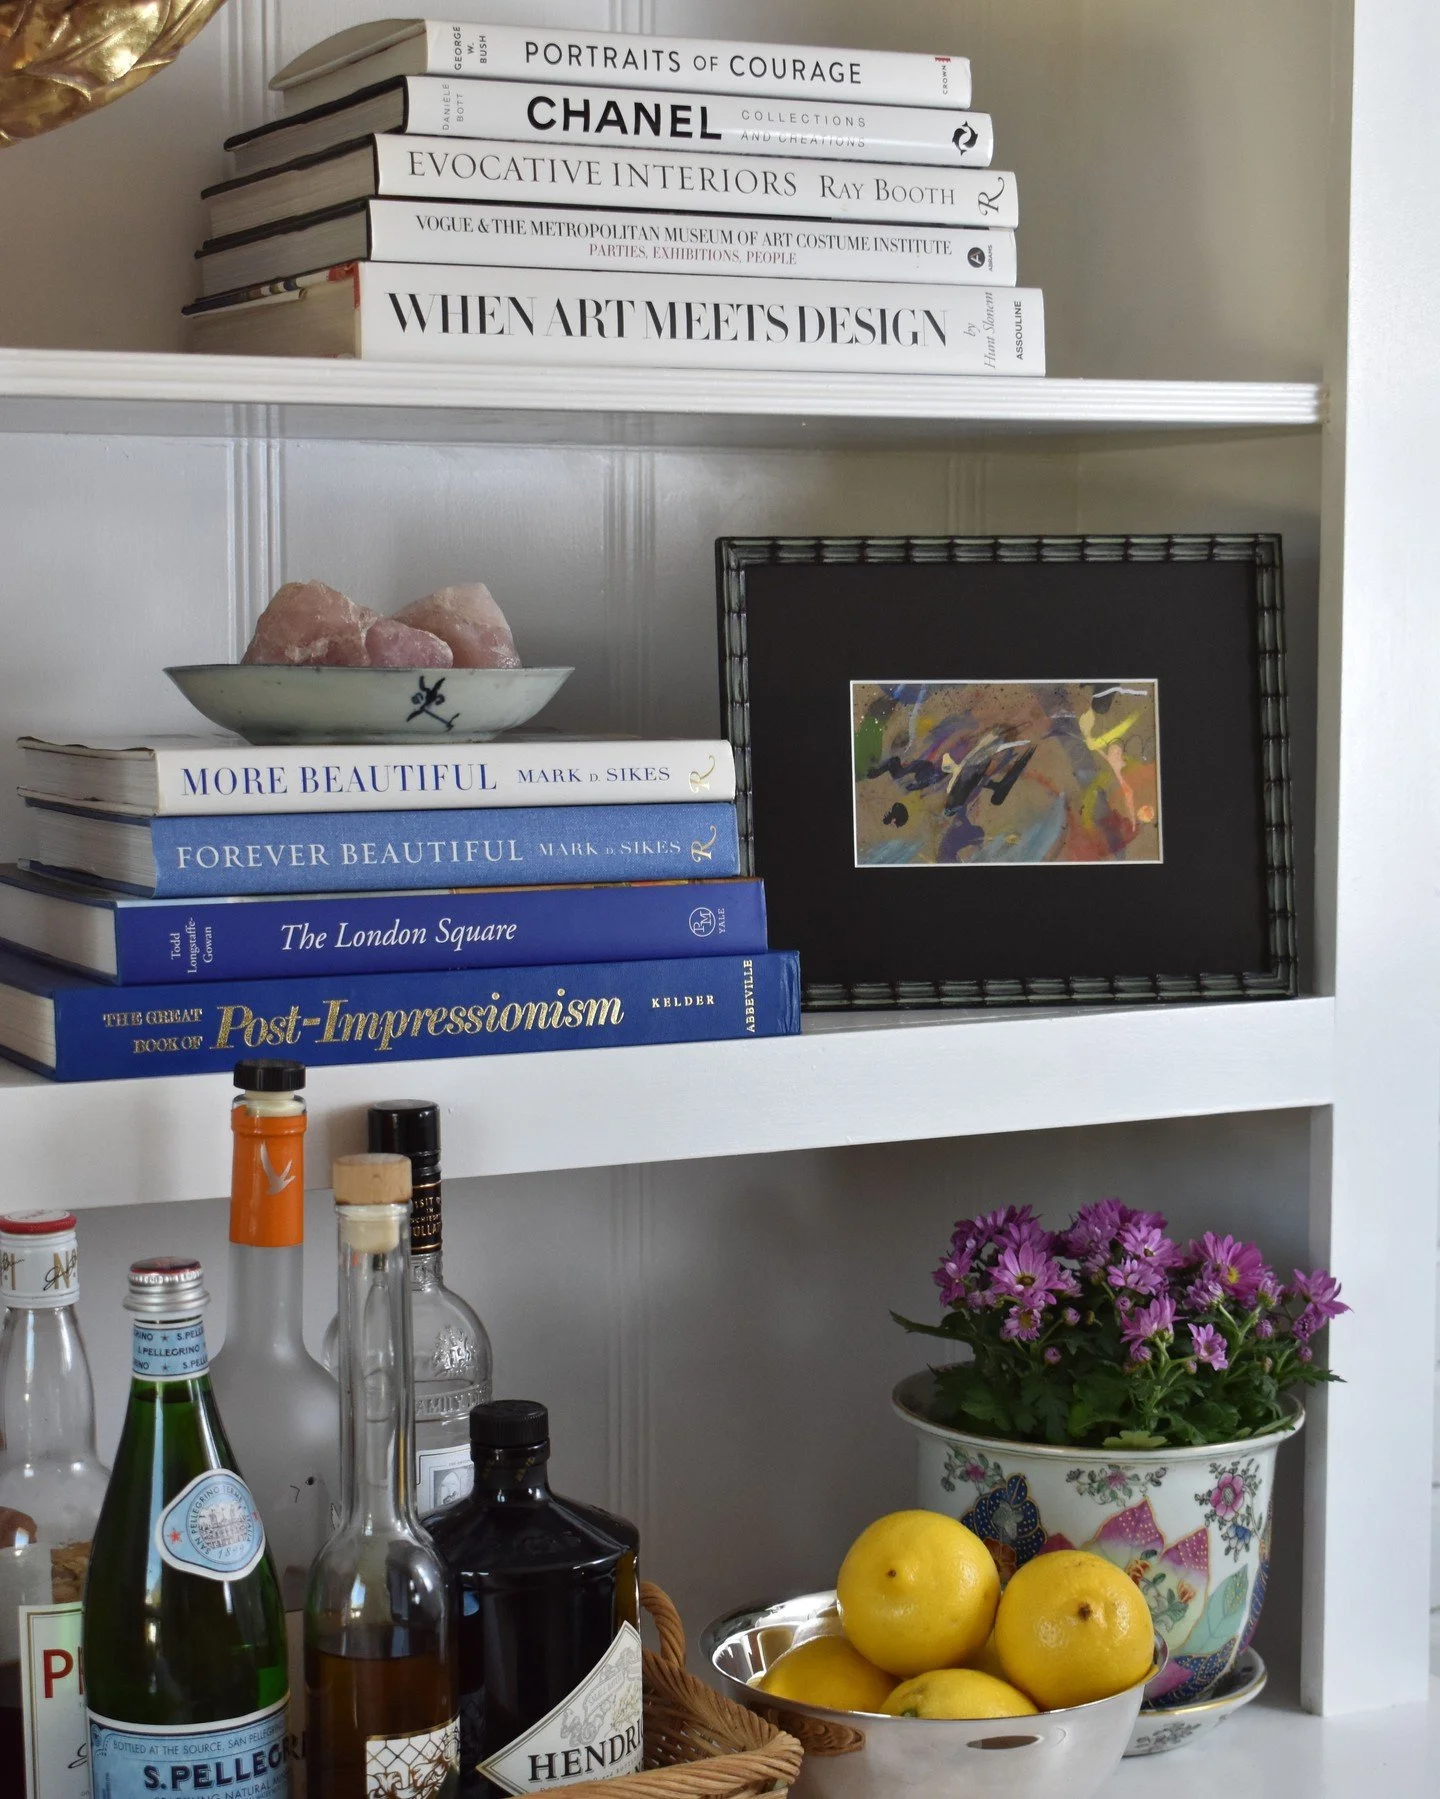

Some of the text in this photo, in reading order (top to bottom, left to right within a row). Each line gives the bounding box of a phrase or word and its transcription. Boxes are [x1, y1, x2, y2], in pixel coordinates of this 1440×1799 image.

[453, 26, 463, 71] GEORGE
[467, 42, 475, 54] W.
[479, 35, 487, 64] BUSH
[525, 41, 862, 85] PORTRAITS OF COURAGE
[456, 94, 464, 122] BOTT
[527, 96, 722, 140] CHANEL
[741, 109, 867, 128] COLLECTIONS
[741, 130, 866, 149] AND CREATIONS
[408, 151, 955, 206] EVOCATIVE INTERIORS RAY BOOTH
[416, 215, 952, 255] VOGUE & THE METROPOLITAN MUSEUM OF ART COSTUME INSTITUTE
[746, 251, 797, 265] PEOPLE
[384, 292, 949, 347] WHEN ART MEETS DESIGN
[964, 322, 981, 337] by
[983, 291, 996, 369] Hunt Slonem
[1013, 300, 1024, 360] ASSOULINE
[181, 766, 288, 796] MORE
[299, 763, 496, 794] BEAUTIFUL
[517, 768, 581, 784] MARK
[606, 767, 671, 782] SIKES
[177, 843, 330, 869] FOREVER
[340, 840, 523, 866] BEAUTIFUL
[539, 842, 598, 857] MARK
[620, 840, 681, 855] SIKES
[281, 918, 517, 952] The London Square
[718, 907, 726, 935] YALE
[170, 932, 181, 960] Todd
[185, 916, 200, 974] Longstaffe-
[203, 926, 214, 964] Gowan
[651, 995, 715, 1010] KELDER
[743, 959, 756, 1033] ABBEVILLE
[103, 1008, 203, 1028] THE GREAT
[209, 988, 625, 1051] Post-Impressionism
[133, 1035, 203, 1054] BOOK OF
[149, 1745, 160, 1755] AT
[162, 1744, 179, 1755] THE
[228, 1737, 247, 1749] SAN
